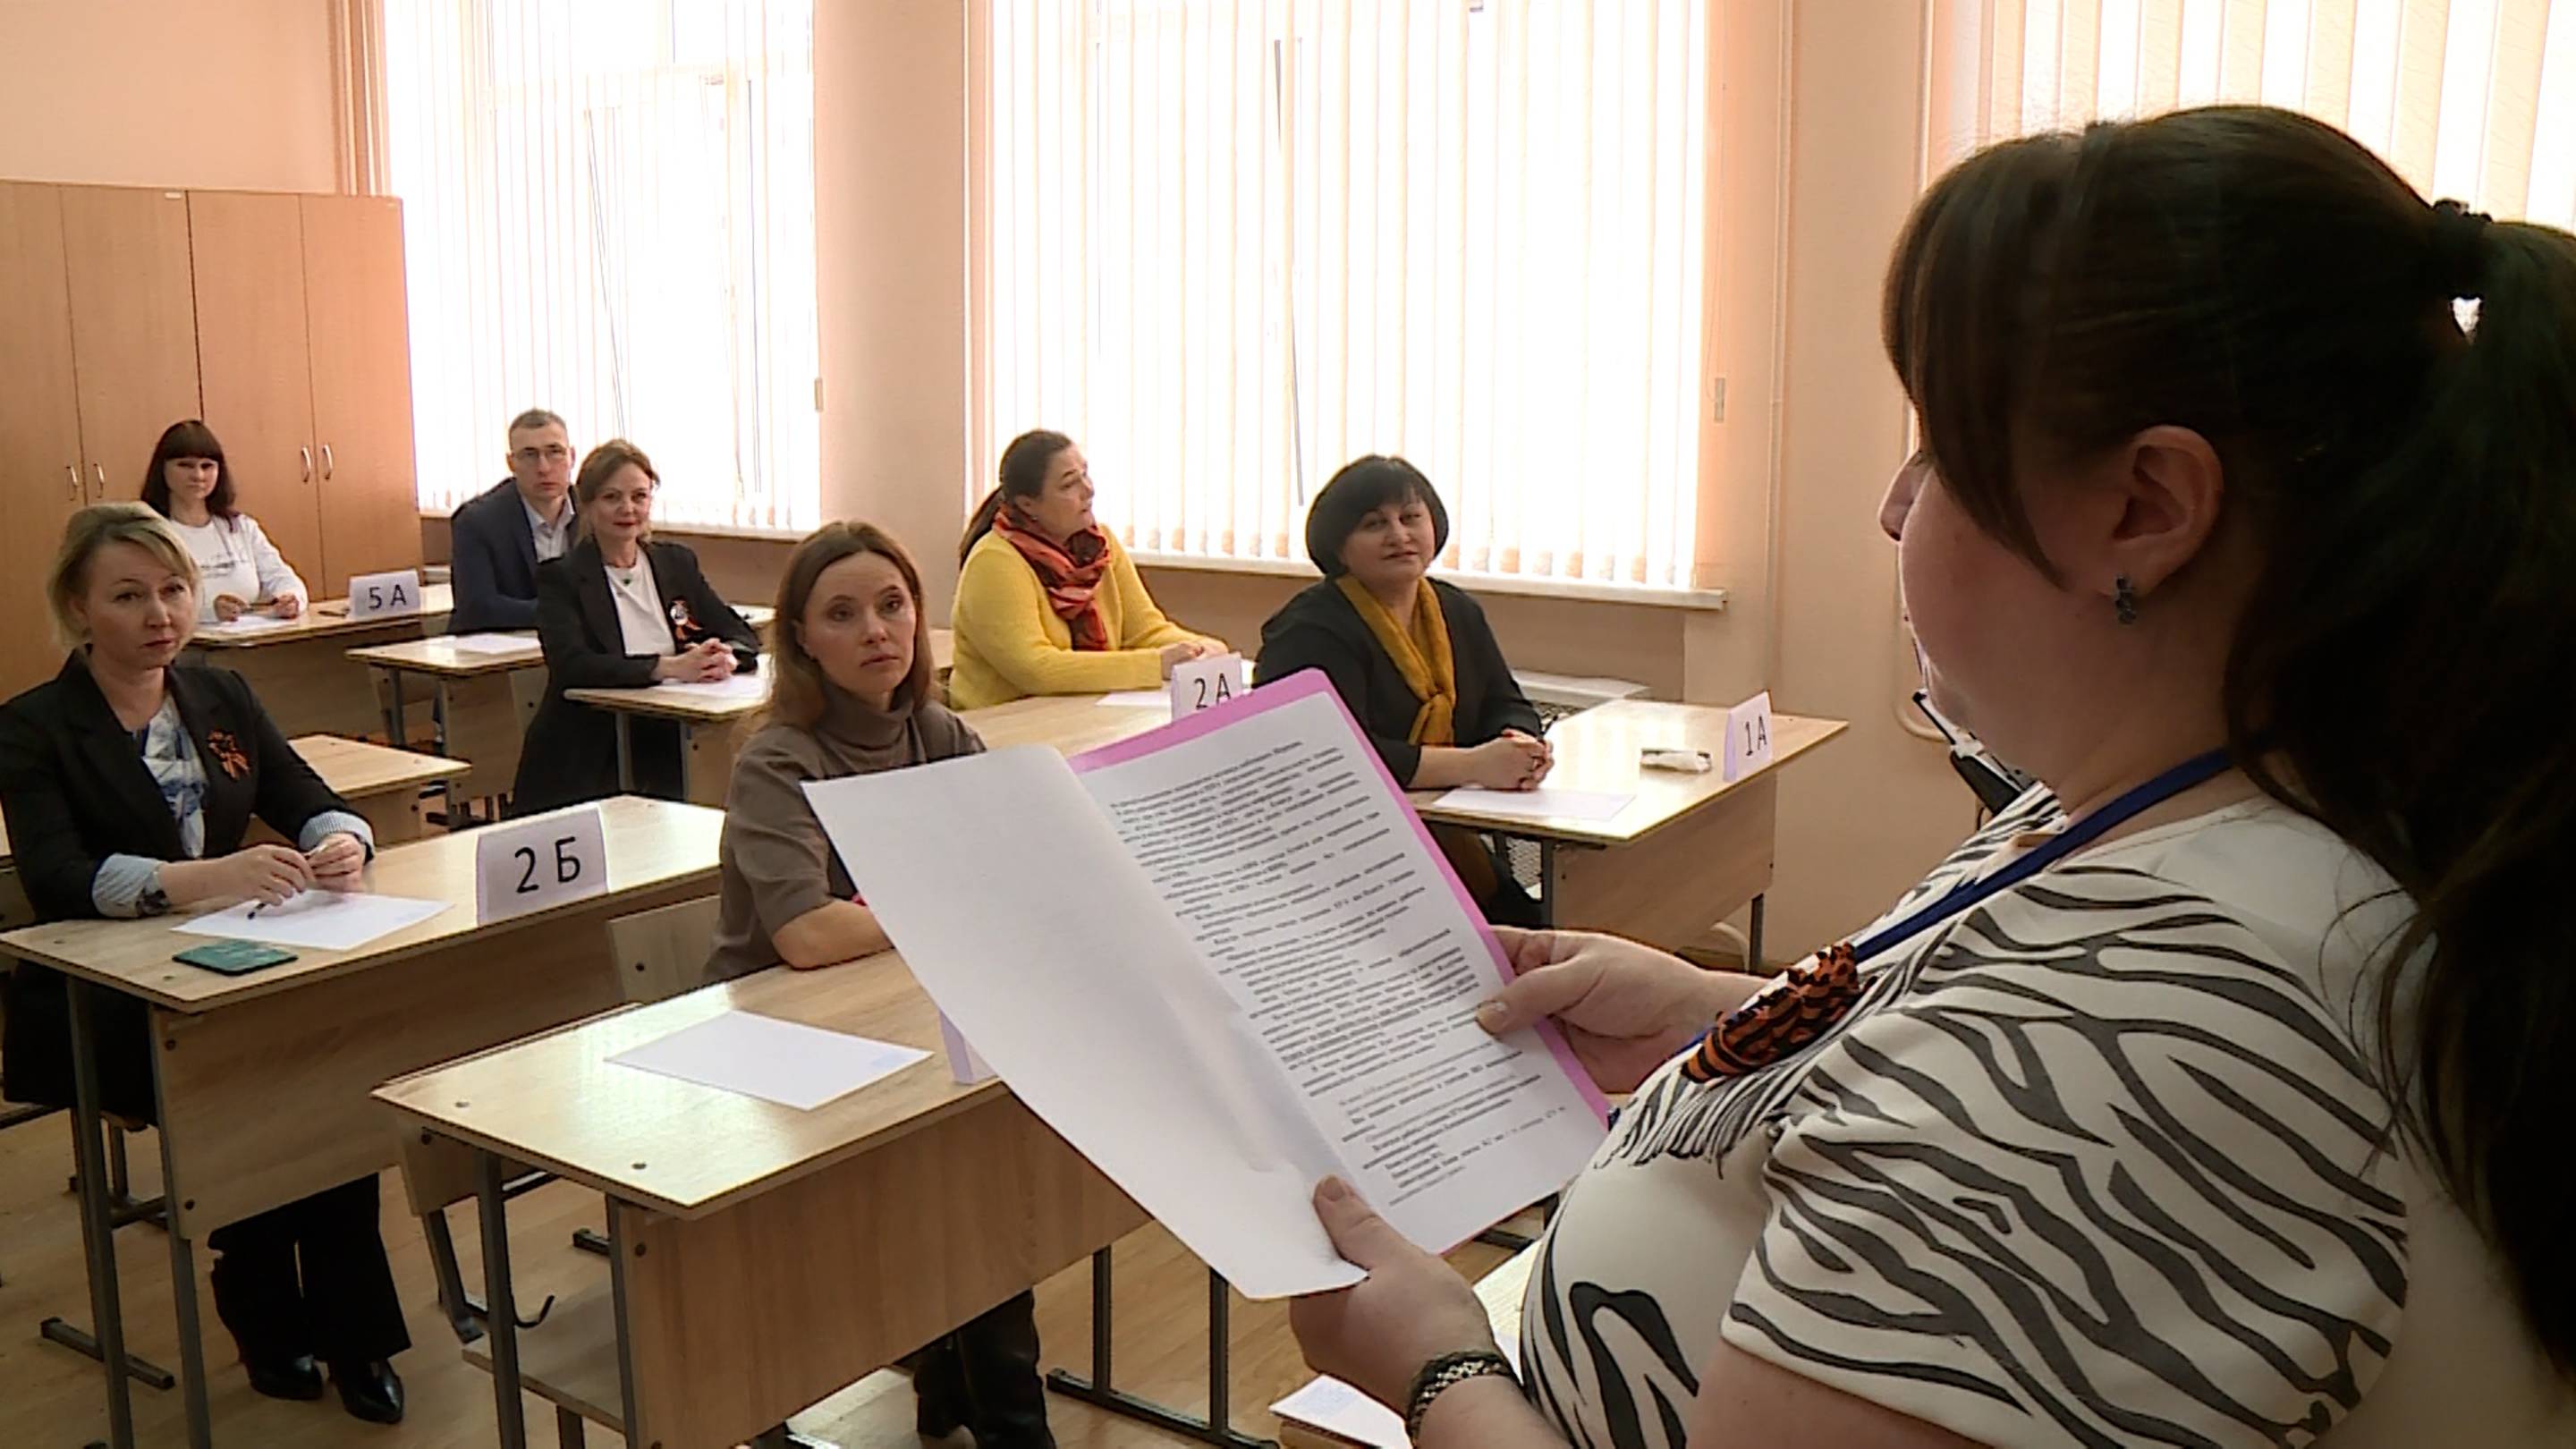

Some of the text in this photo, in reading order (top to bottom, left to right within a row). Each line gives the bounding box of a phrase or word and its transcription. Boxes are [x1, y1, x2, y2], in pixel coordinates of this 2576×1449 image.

[368, 583, 407, 610] 5 А
[1194, 673, 1232, 710] 2 А
[1745, 715, 1768, 757] 1 А
[514, 836, 580, 894] 2 Б
